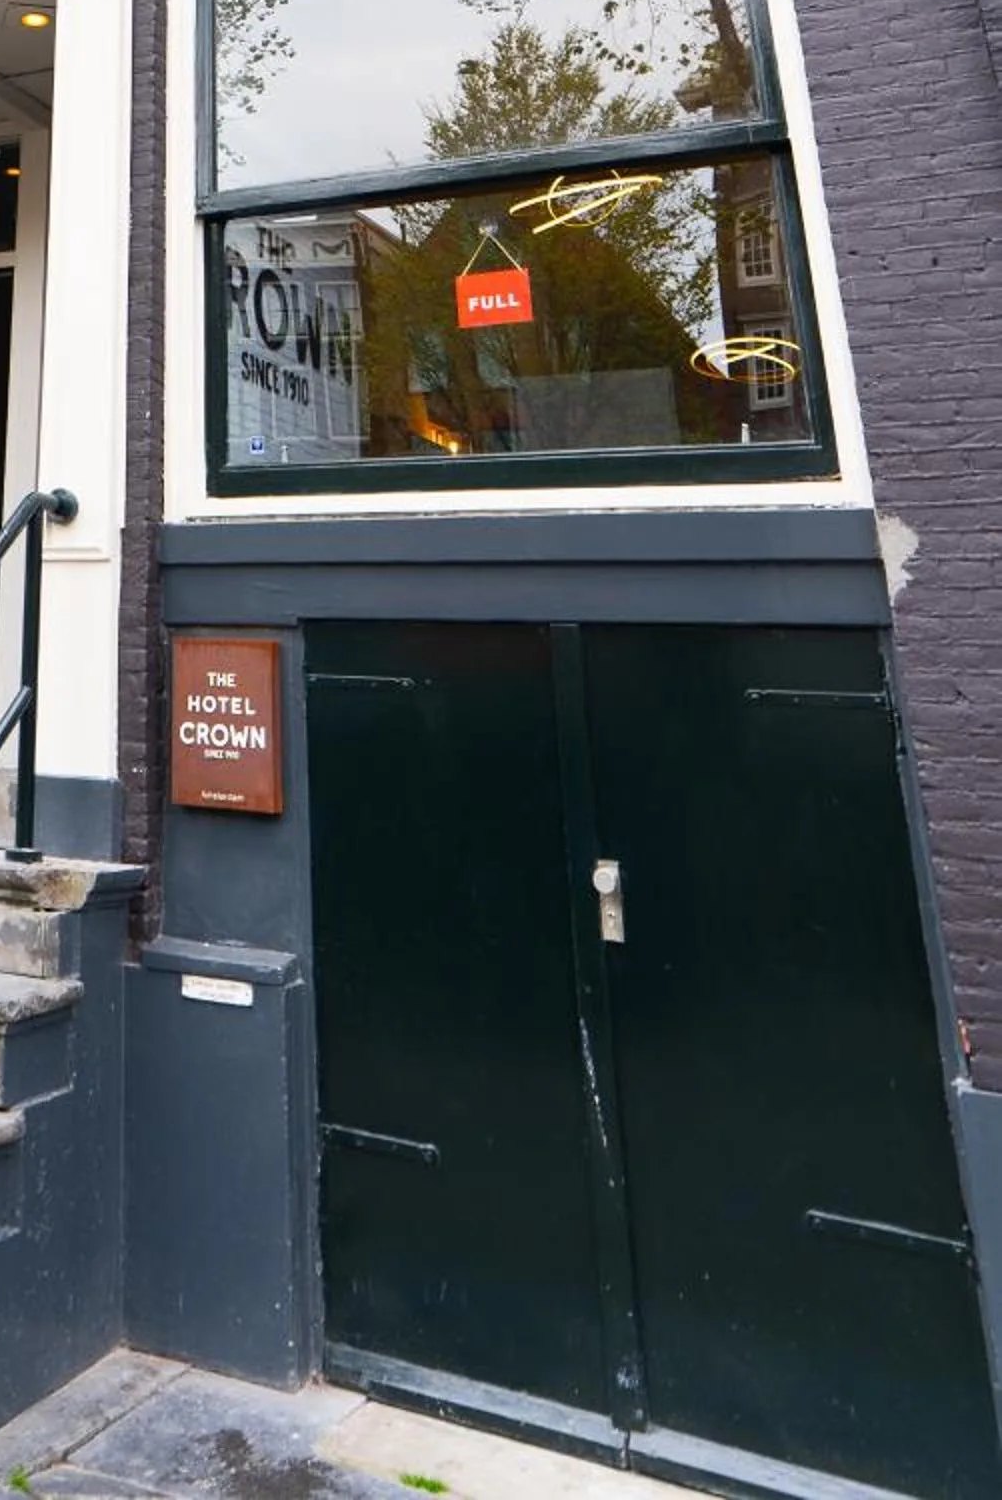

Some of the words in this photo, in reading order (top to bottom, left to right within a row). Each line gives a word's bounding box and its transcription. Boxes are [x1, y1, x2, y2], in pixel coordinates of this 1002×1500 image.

[469, 293, 521, 312] FULL
[241, 351, 281, 395] SINCE
[272, 369, 309, 406] 1910
[206, 671, 237, 688] THE
[187, 695, 257, 716] HOTEL
[179, 721, 266, 749] CROWN
